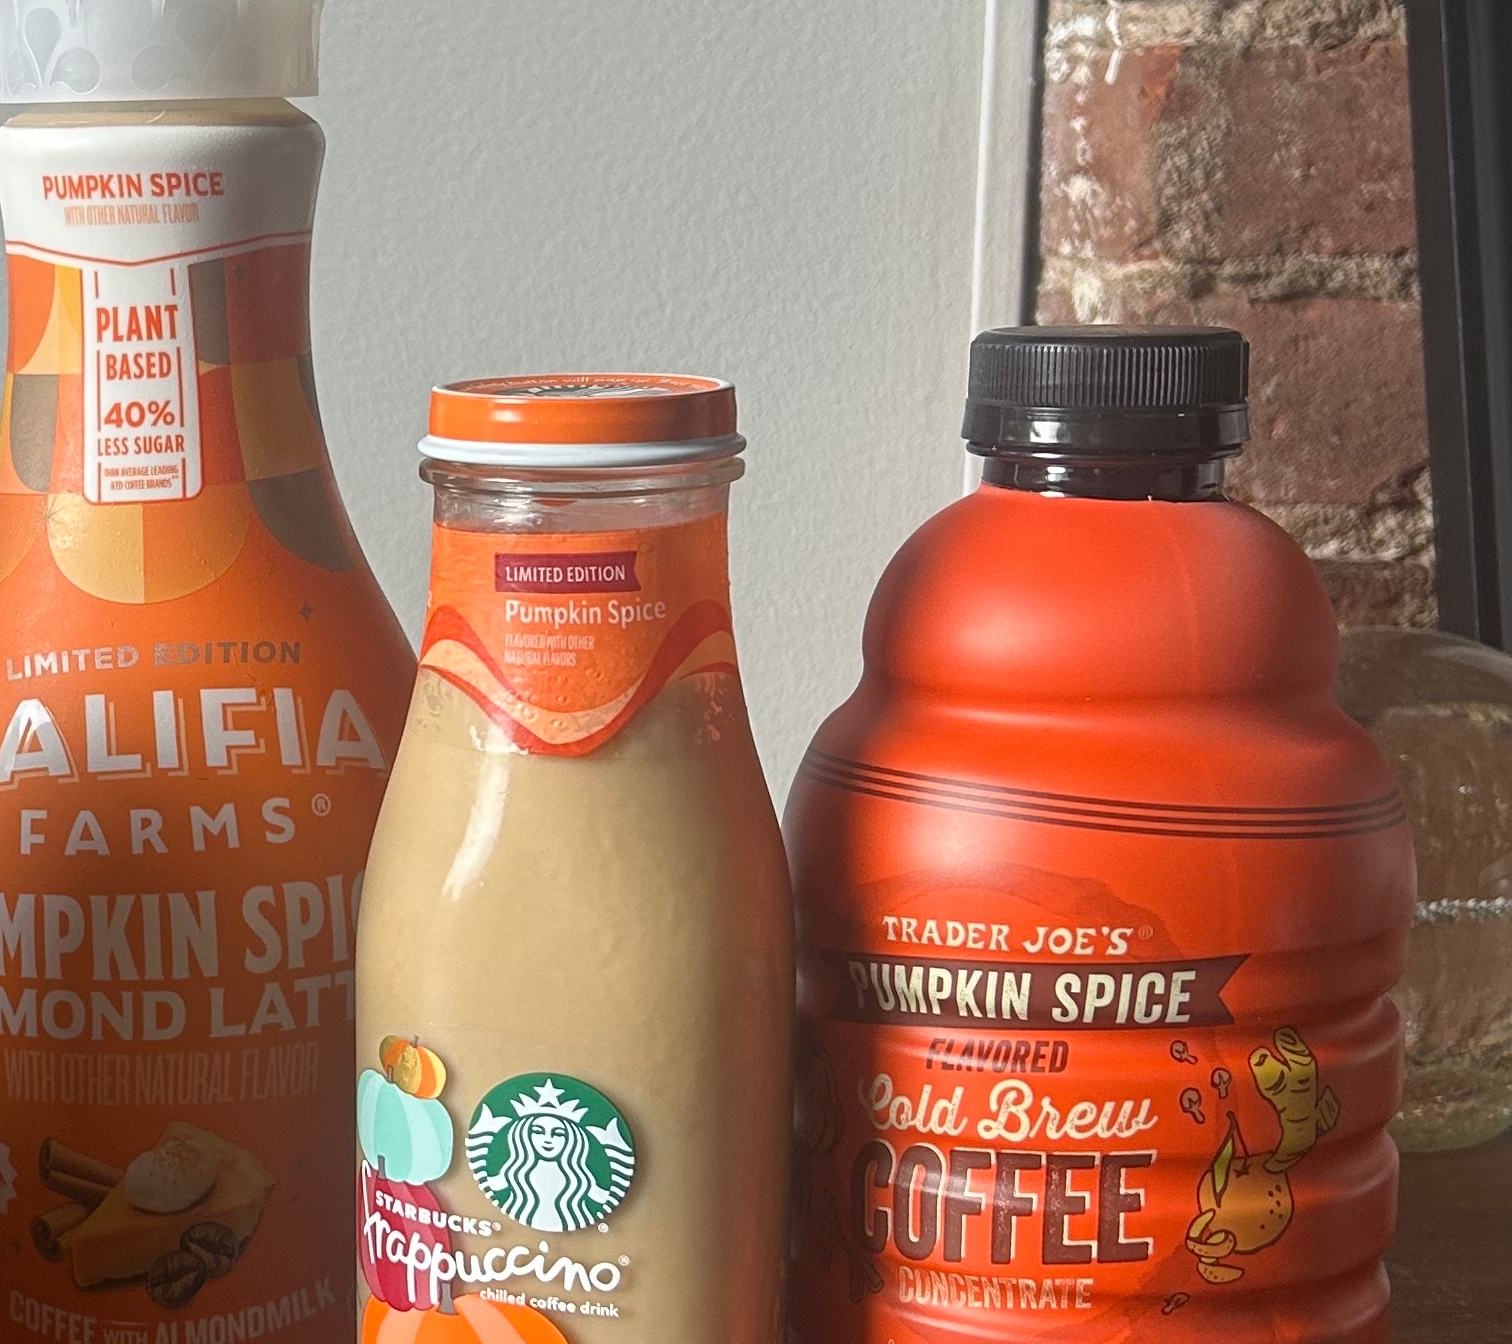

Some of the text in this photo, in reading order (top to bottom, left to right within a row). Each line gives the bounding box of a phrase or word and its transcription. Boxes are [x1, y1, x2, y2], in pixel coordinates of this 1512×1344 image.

[42, 172, 225, 201] PUMPKIN SPICE
[96, 304, 178, 343] PLANT
[105, 346, 172, 380] BASED
[104, 400, 176, 429] 40%
[97, 434, 185, 457] LESS SUGAR
[505, 565, 626, 583] LIMITED EDITION
[505, 597, 667, 630] Pumpkin Spice
[504, 633, 545, 649] FLAVORED
[6, 641, 302, 681] LIMITED EDITION
[241, 868, 365, 974] SPI
[882, 915, 1010, 952] TRADER
[208, 968, 356, 1039] LATT
[846, 959, 1198, 1025] PUMPKIN SPICE
[3, 1040, 321, 1106] WITH OTHER NATURAL FLAVOR
[925, 1037, 1070, 1074] FLAVORED
[858, 1072, 1159, 1143] Cold Brew
[850, 1137, 1159, 1265] COFFEE
[479, 1287, 620, 1319] chilled coffee drink
[897, 1264, 1094, 1310] CONCENTRATE
